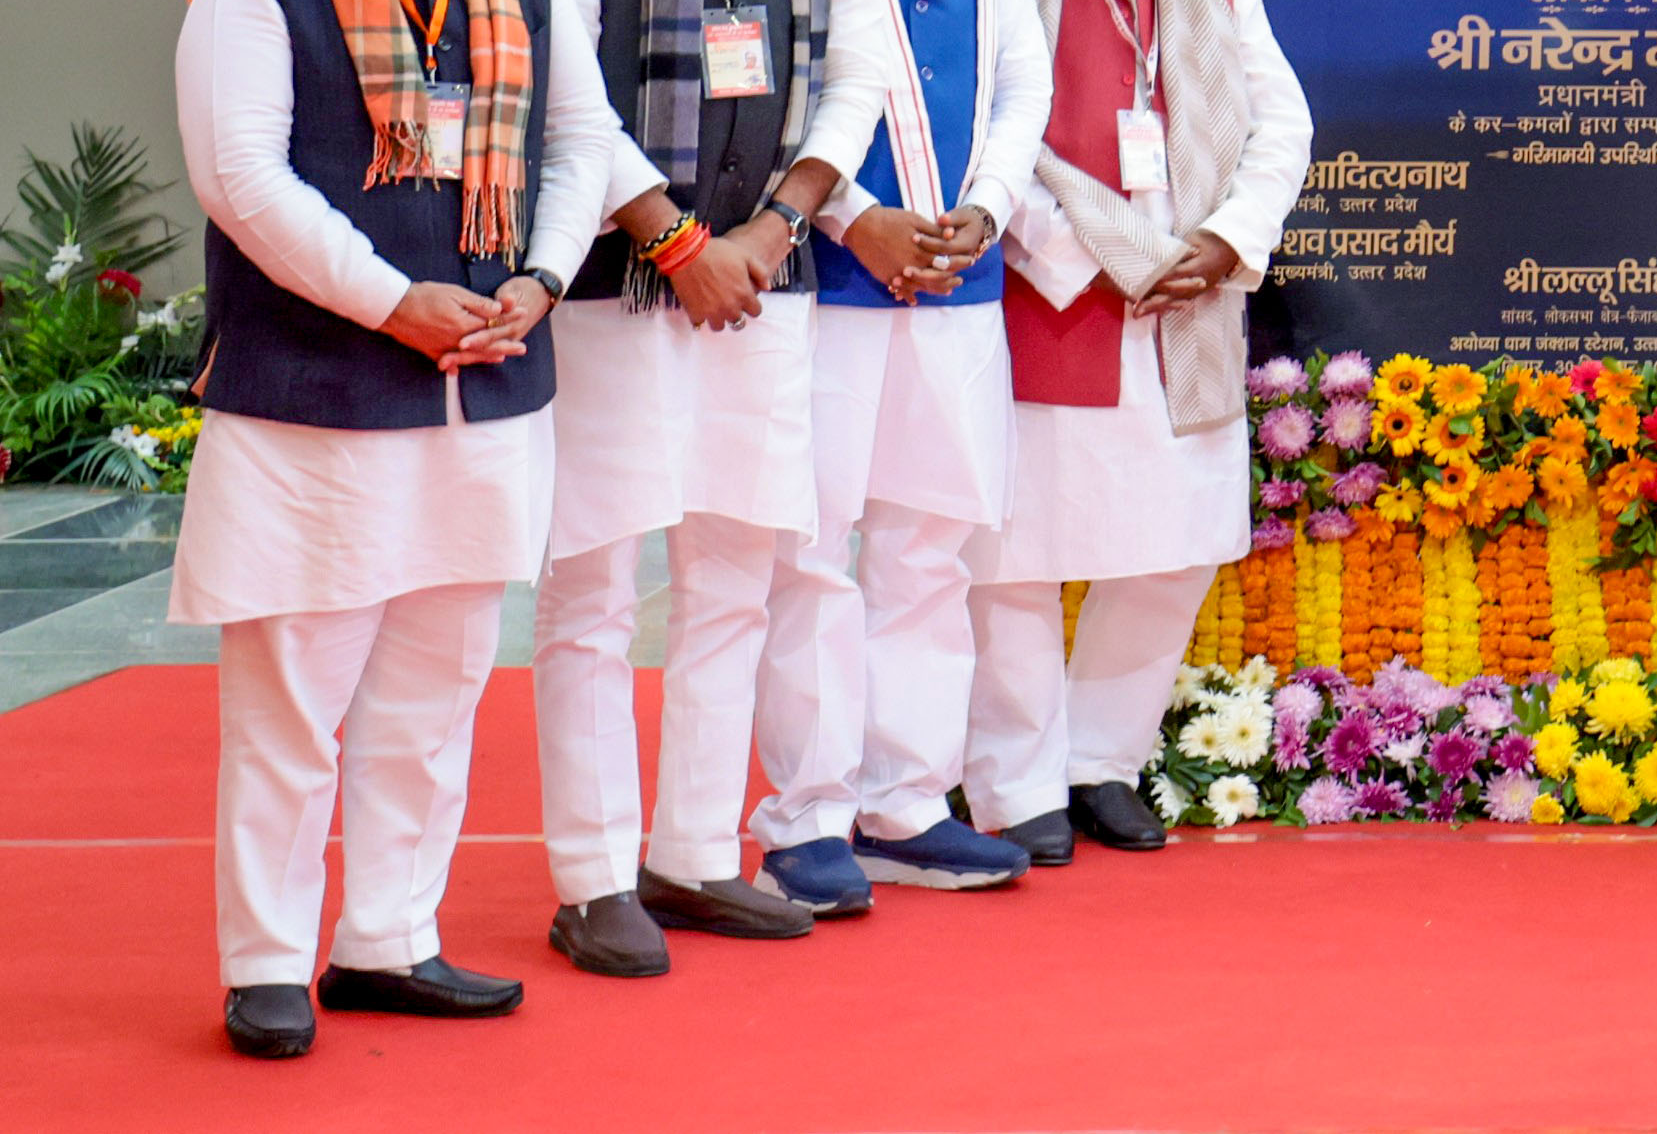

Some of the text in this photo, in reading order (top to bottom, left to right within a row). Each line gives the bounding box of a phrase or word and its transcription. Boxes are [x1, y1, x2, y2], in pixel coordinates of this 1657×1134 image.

[1427, 15, 1496, 70] श्री
[1500, 17, 1640, 77] नरेन्द्र
[1538, 78, 1648, 108] प्रधानमंत्री
[1448, 110, 1466, 134] के
[1579, 116, 1617, 137] द्वारा
[1512, 141, 1596, 165] गरिमामयी
[1292, 193, 1420, 214] मंत्री, उत्तर प्रदेश
[1272, 219, 1458, 259] शव प्रसाद मौर्य
[1348, 265, 1386, 281] उत्तर
[1393, 261, 1428, 280] प्रदेश
[1503, 258, 1541, 294] श्री
[1542, 266, 1618, 306] लल्लू
[1545, 305, 1594, 324] लोकसभा
[1504, 337, 1531, 351] धाम
